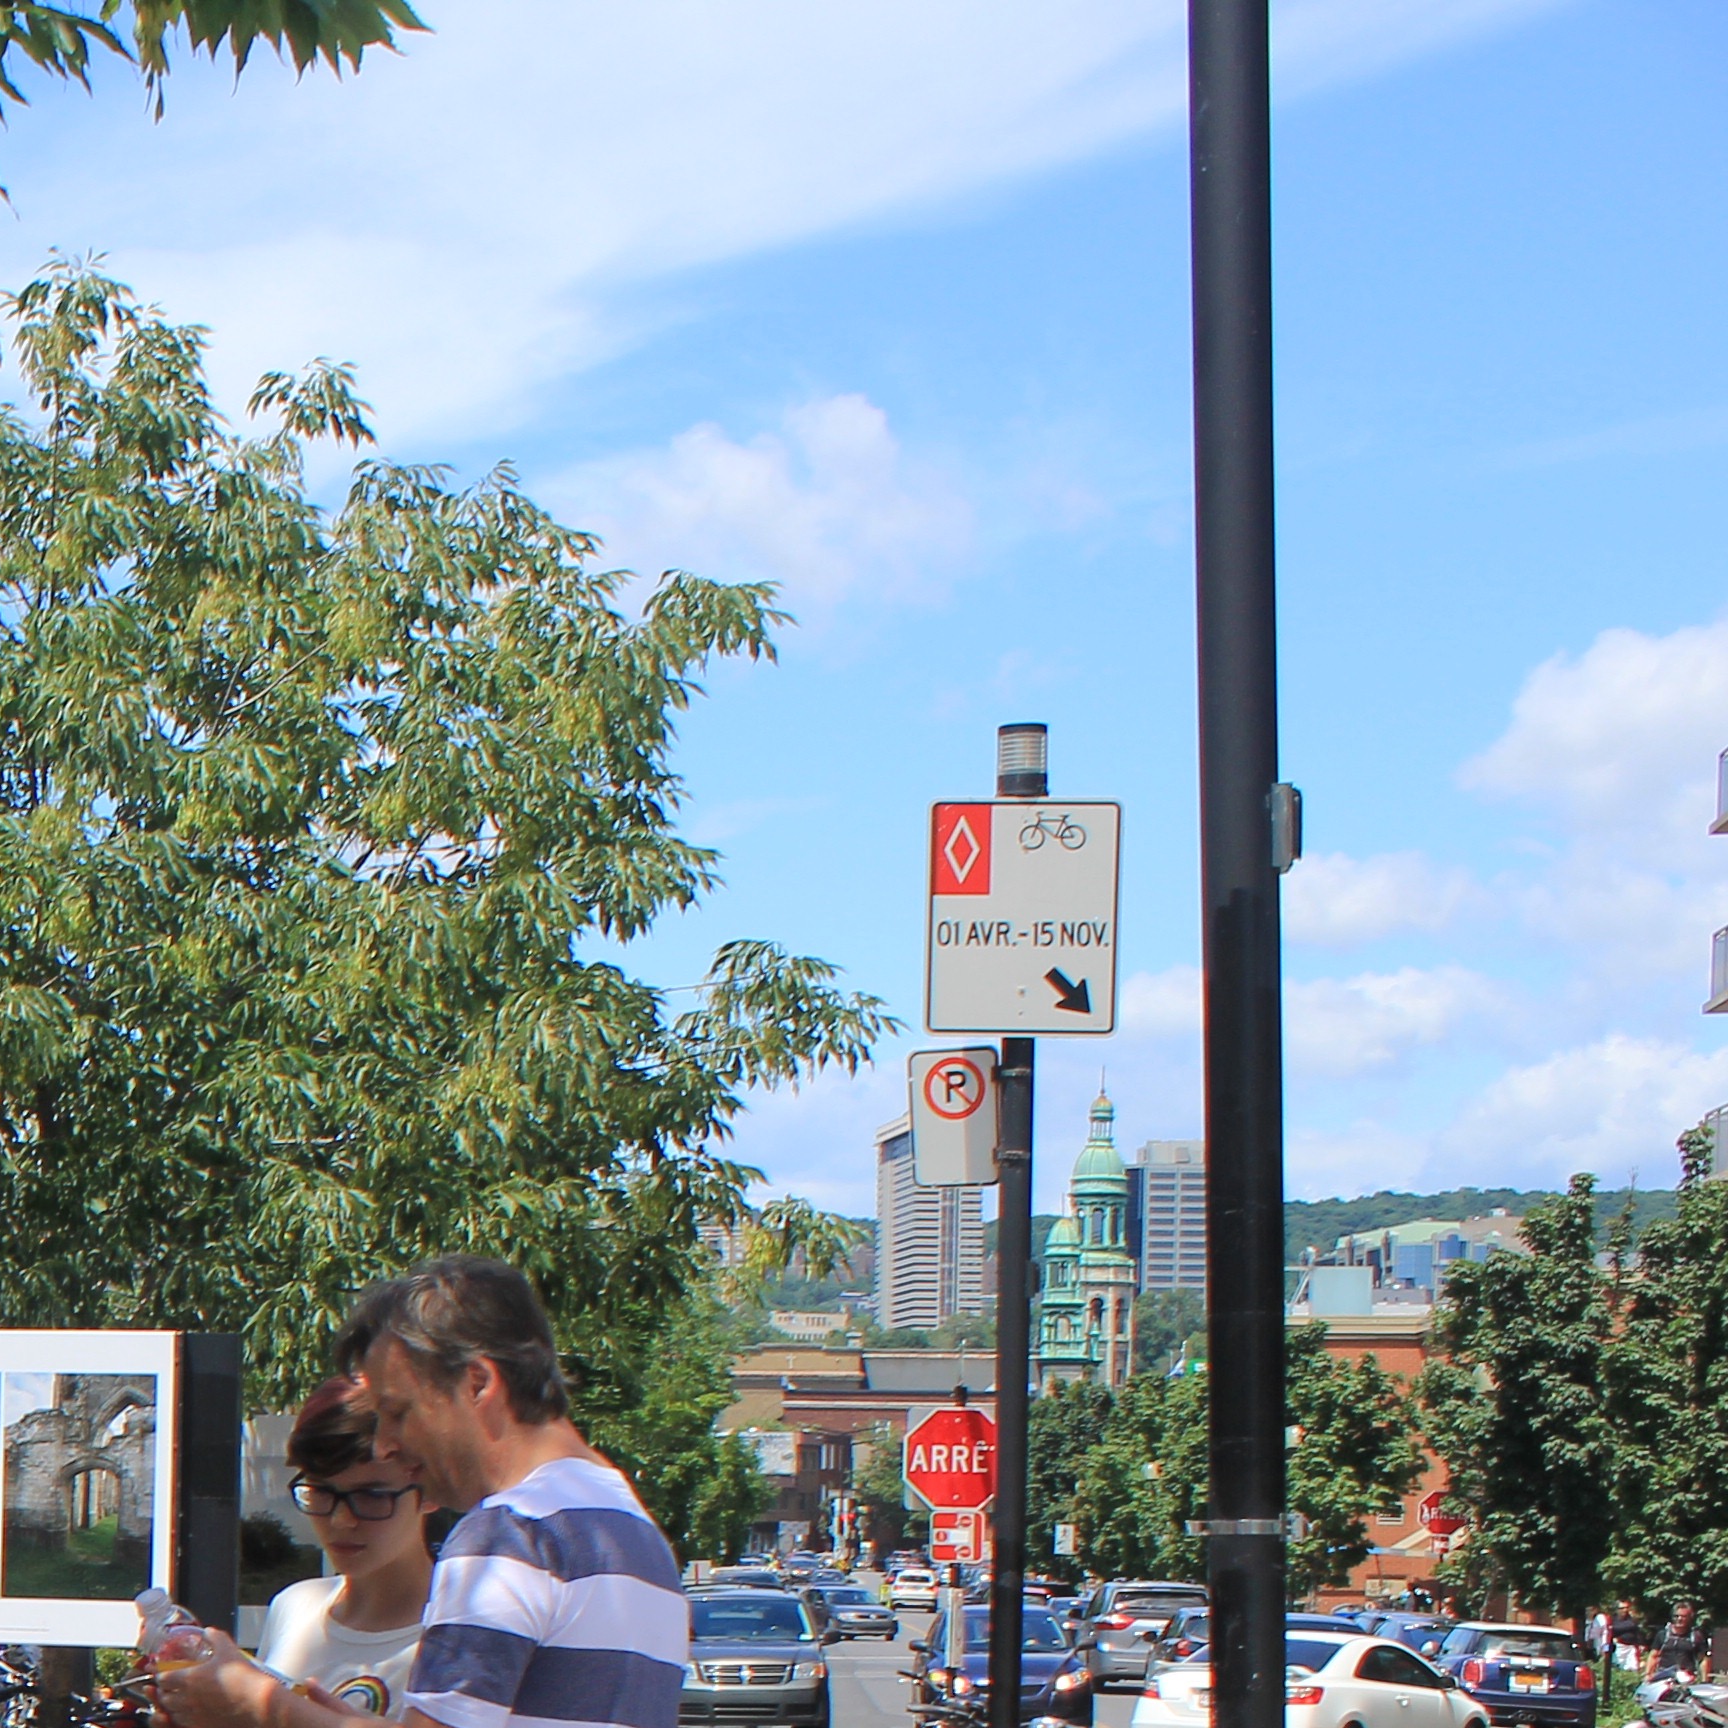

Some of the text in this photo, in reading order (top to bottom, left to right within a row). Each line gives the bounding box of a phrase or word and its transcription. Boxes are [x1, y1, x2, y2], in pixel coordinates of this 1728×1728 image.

[937, 921, 959, 946] 01
[1060, 921, 1110, 947] NOV.
[909, 1440, 995, 1474] ARRÊ
